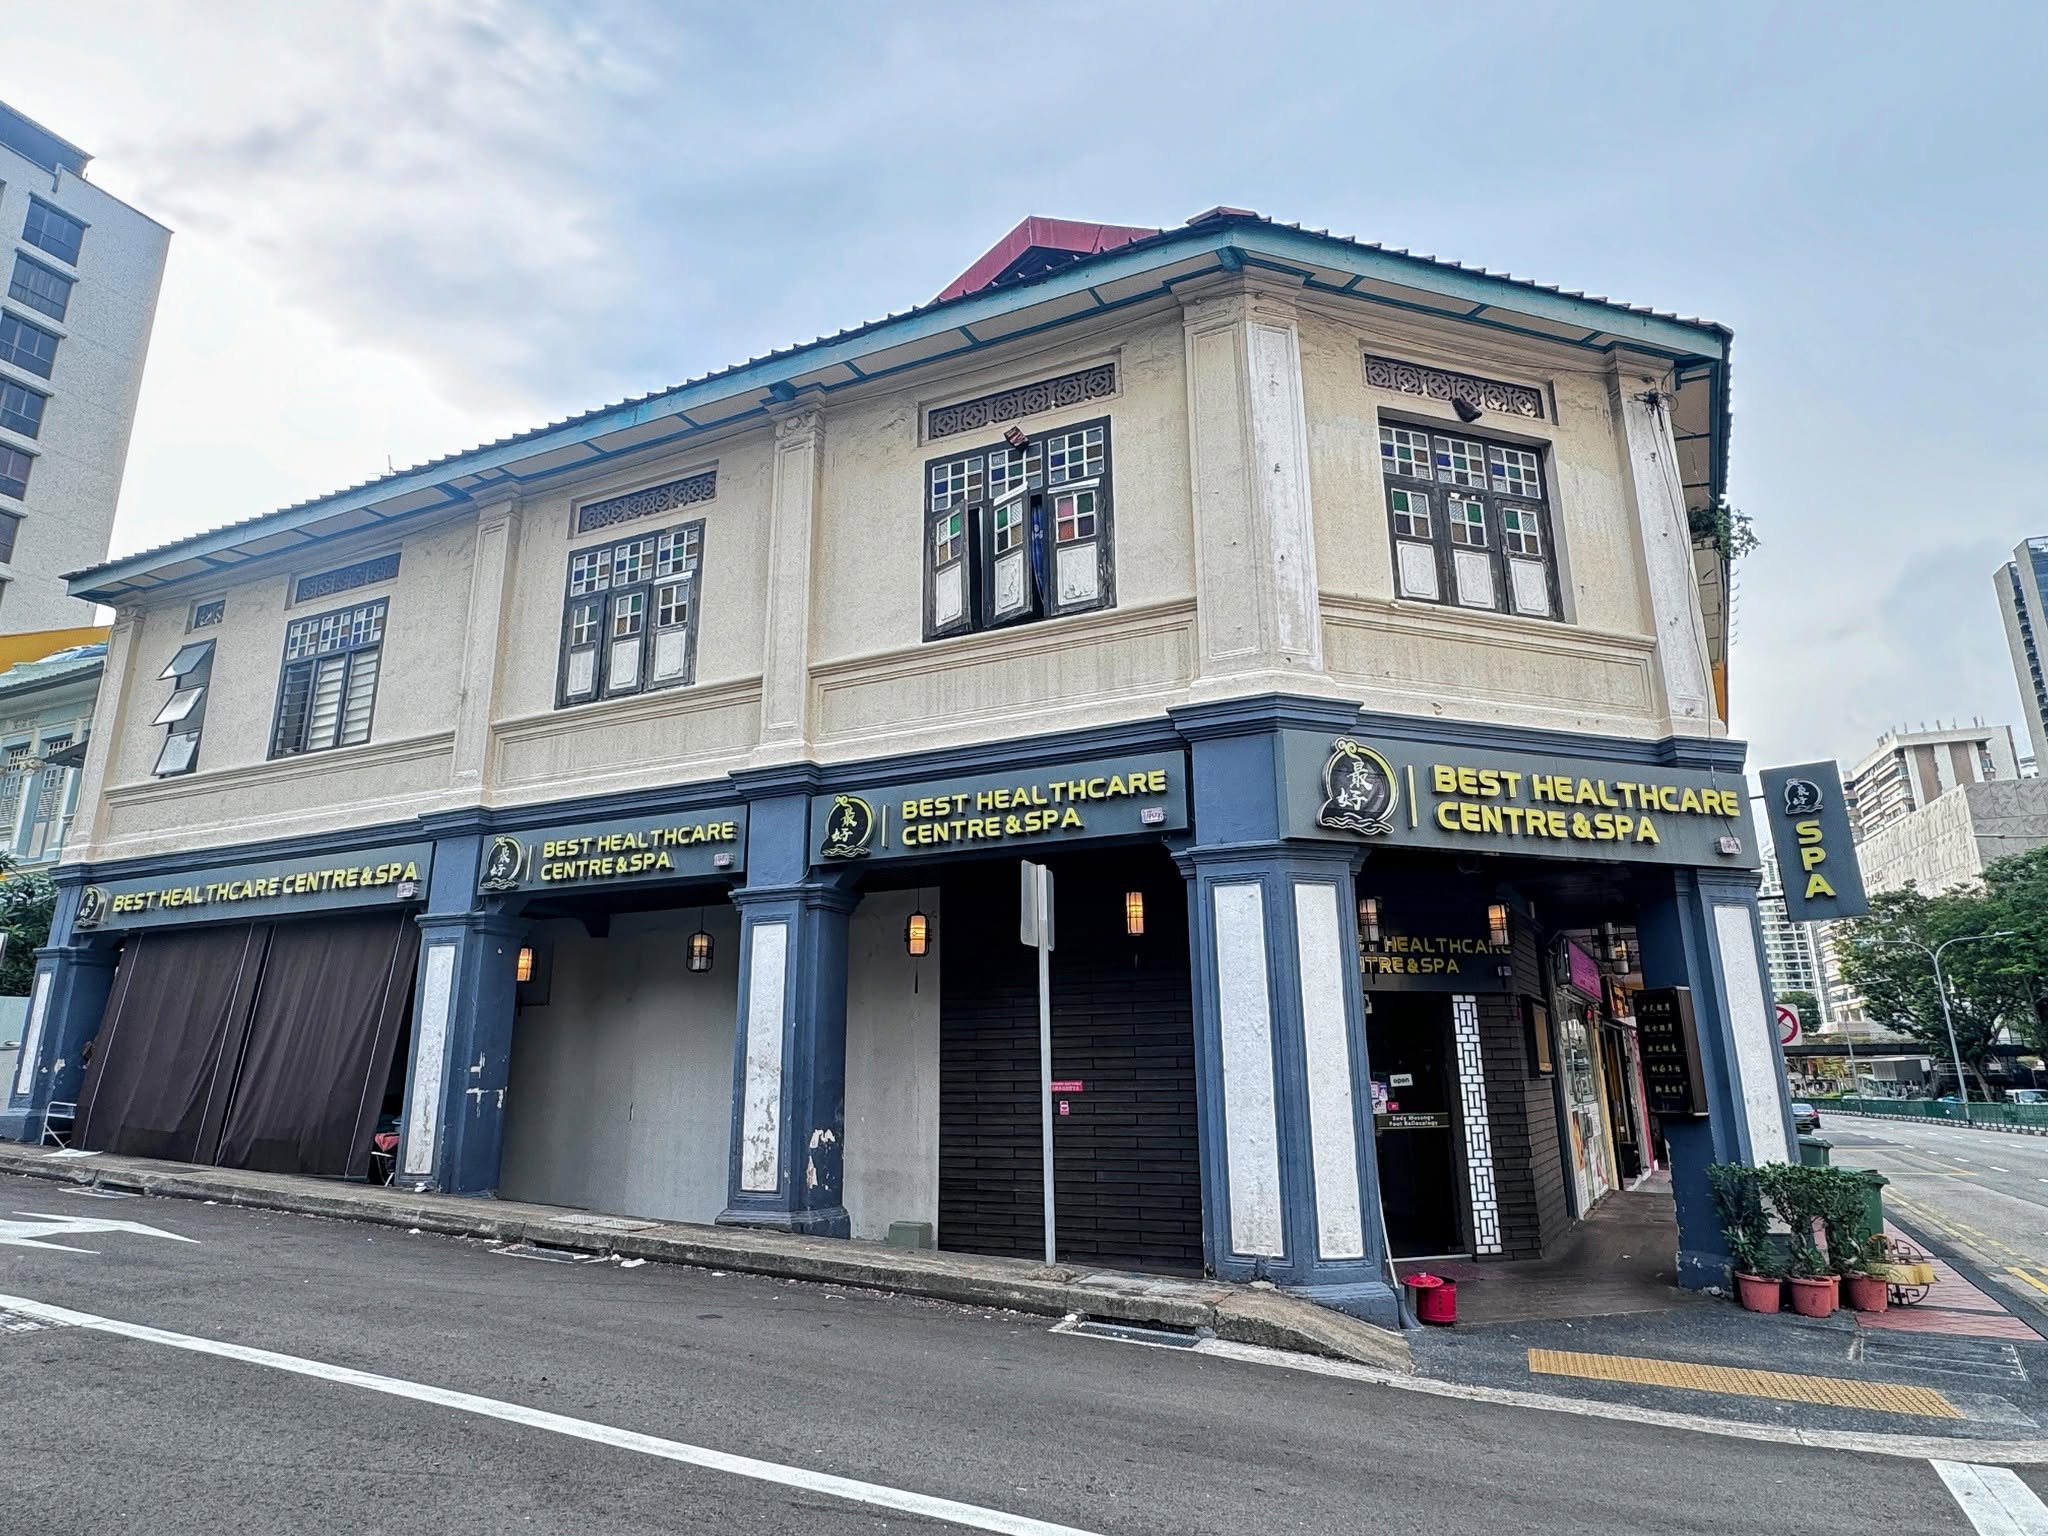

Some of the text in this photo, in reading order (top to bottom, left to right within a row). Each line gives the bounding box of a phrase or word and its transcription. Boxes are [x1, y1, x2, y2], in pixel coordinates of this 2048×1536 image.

[903, 769, 1167, 820] BEST HEALTHCARE
[1336, 761, 1373, 811] 最好
[1433, 765, 1740, 817] BEST HEALTHCARE
[543, 821, 735, 858] BEST HEALTHCARE
[831, 807, 857, 842] 最好
[1796, 820, 1837, 899] SPA
[112, 889, 157, 913] BEST
[159, 877, 280, 906] HEALTHCARE
